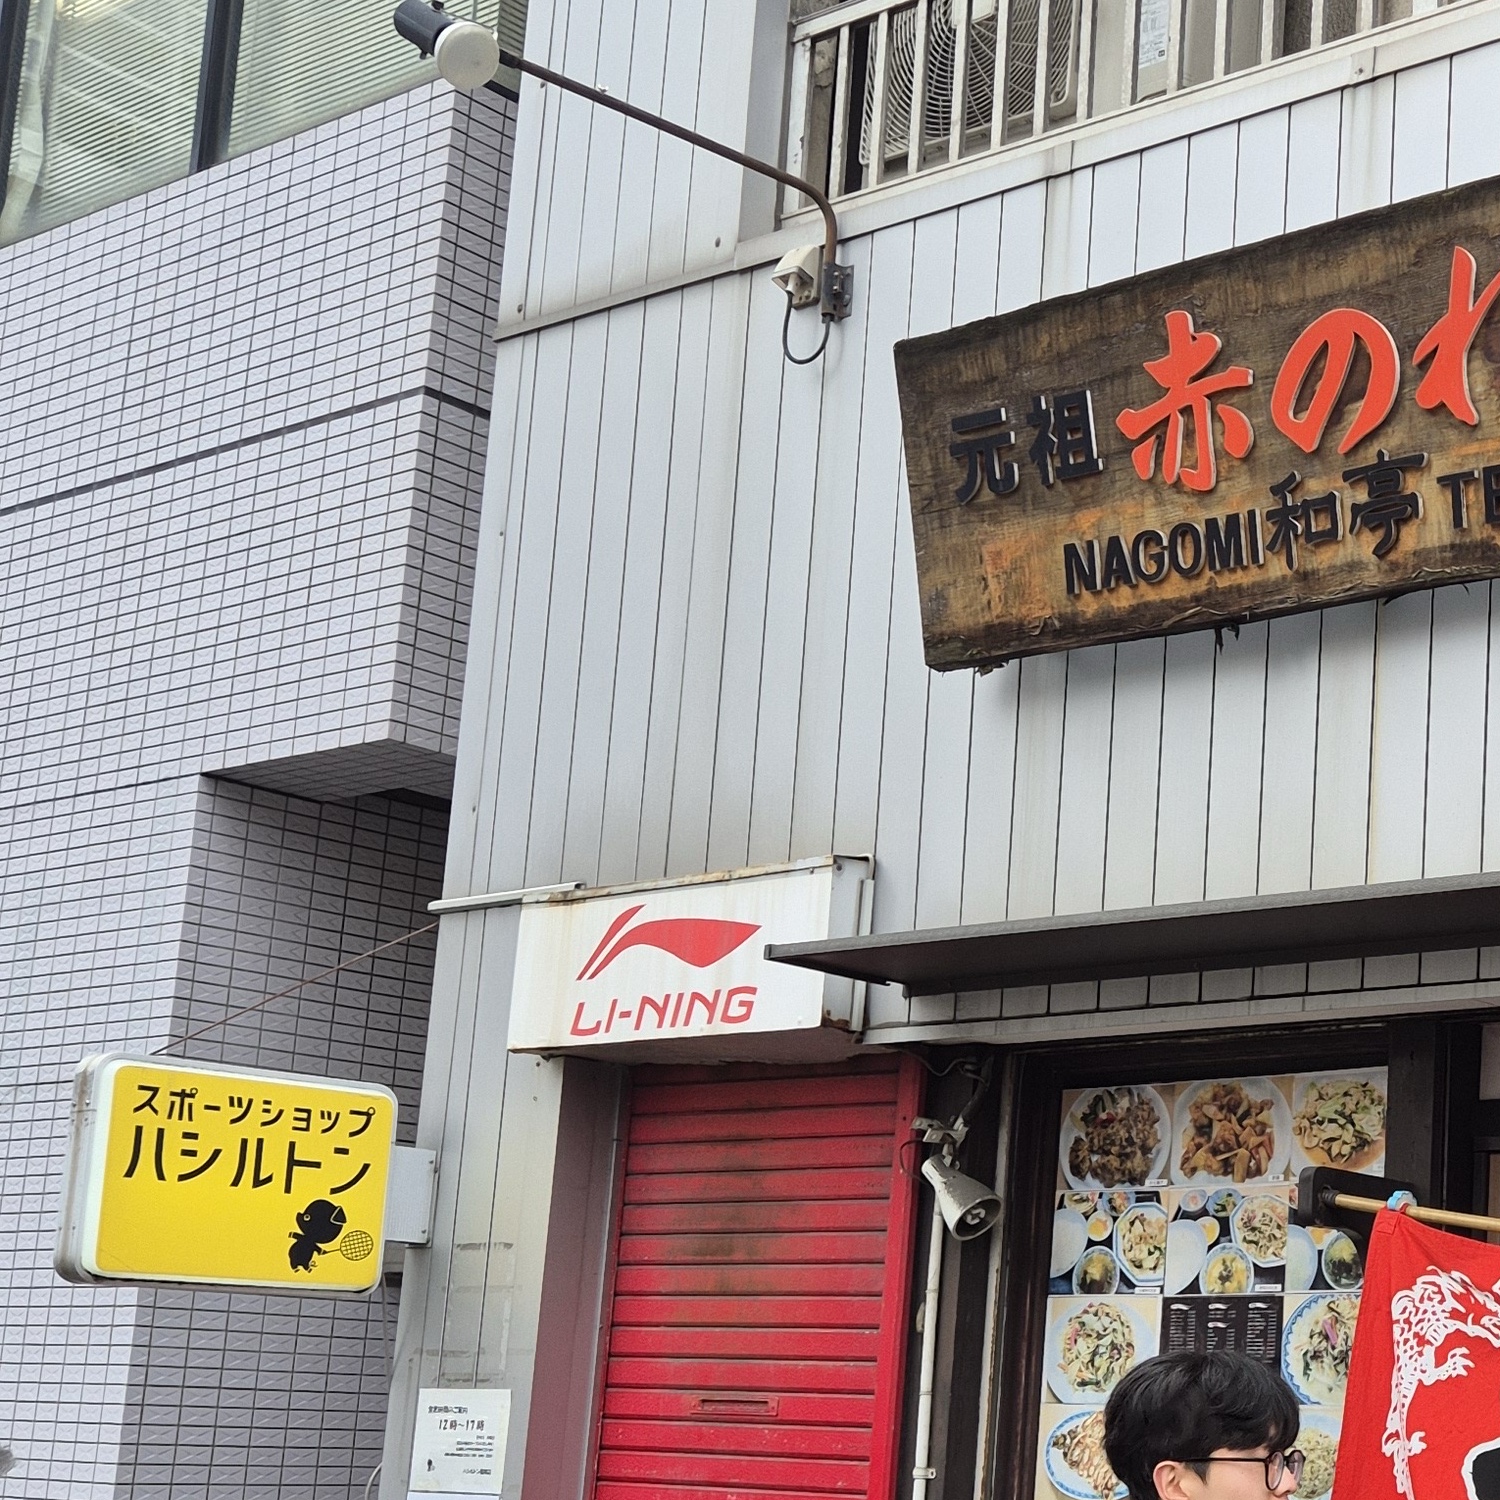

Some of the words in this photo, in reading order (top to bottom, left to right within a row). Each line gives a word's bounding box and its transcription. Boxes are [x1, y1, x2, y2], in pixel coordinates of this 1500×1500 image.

[949, 388, 1105, 505] 元祖
[1063, 508, 1263, 597] NAGOMI
[1264, 449, 1429, 571] 和亭
[570, 985, 759, 1038] LI-NING
[132, 1083, 377, 1138] スポーツショップ
[122, 1123, 374, 1196] ハシルトン
